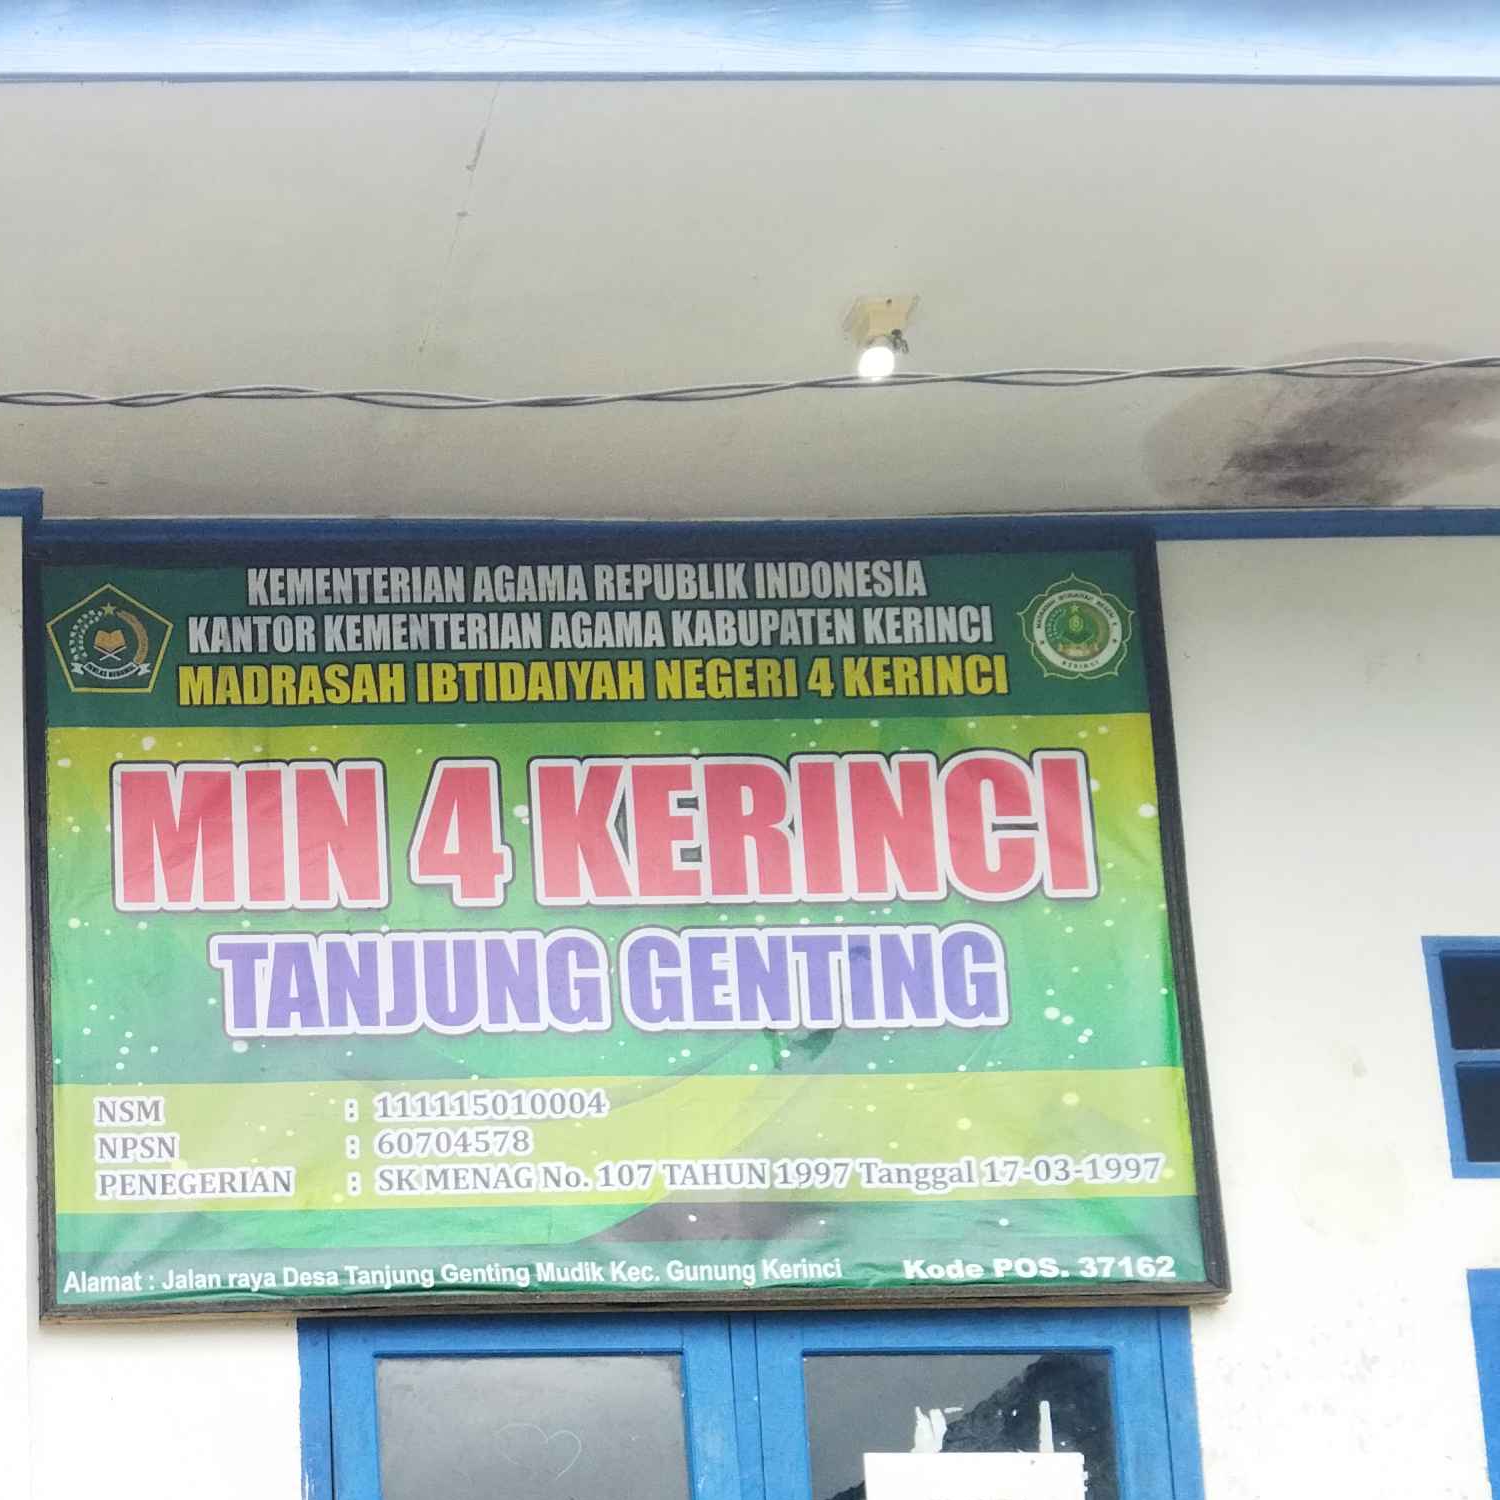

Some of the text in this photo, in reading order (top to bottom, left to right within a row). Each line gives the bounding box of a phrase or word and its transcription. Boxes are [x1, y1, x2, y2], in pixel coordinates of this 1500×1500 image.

[248, 560, 927, 606] KEMENTERIAN AGAMA REPUBLIK INDONESIA
[189, 615, 316, 653] KANTOR
[324, 612, 543, 652] KEMENTERIAN
[549, 609, 663, 648] AGAMA
[673, 607, 857, 646] KABUPATEN
[863, 606, 994, 644] KERINCI
[179, 662, 405, 705] MADRASAH
[417, 660, 645, 702] IBTIDAIYAH
[656, 657, 798, 699] NEGERI
[807, 657, 834, 698] 4
[844, 655, 1009, 697] KERINCI
[112, 751, 1100, 911] MIN 4 KERINCI
[209, 923, 1010, 1038] TANJUNG GENTING
[94, 1088, 609, 1127] NSM 111115010004
[96, 1130, 532, 1161] NPSN 60704578
[98, 1155, 1164, 1198] PENEGERIAN SK MENAG No. 107 TAHUN 1997 Tanggal 17-03-1997
[64, 1257, 842, 1293] Alamat Jalan raya Desa Tanjung Genting Mudik Kec. Gunung Kerinci
[903, 1255, 1176, 1279] Kode POS. 37162
